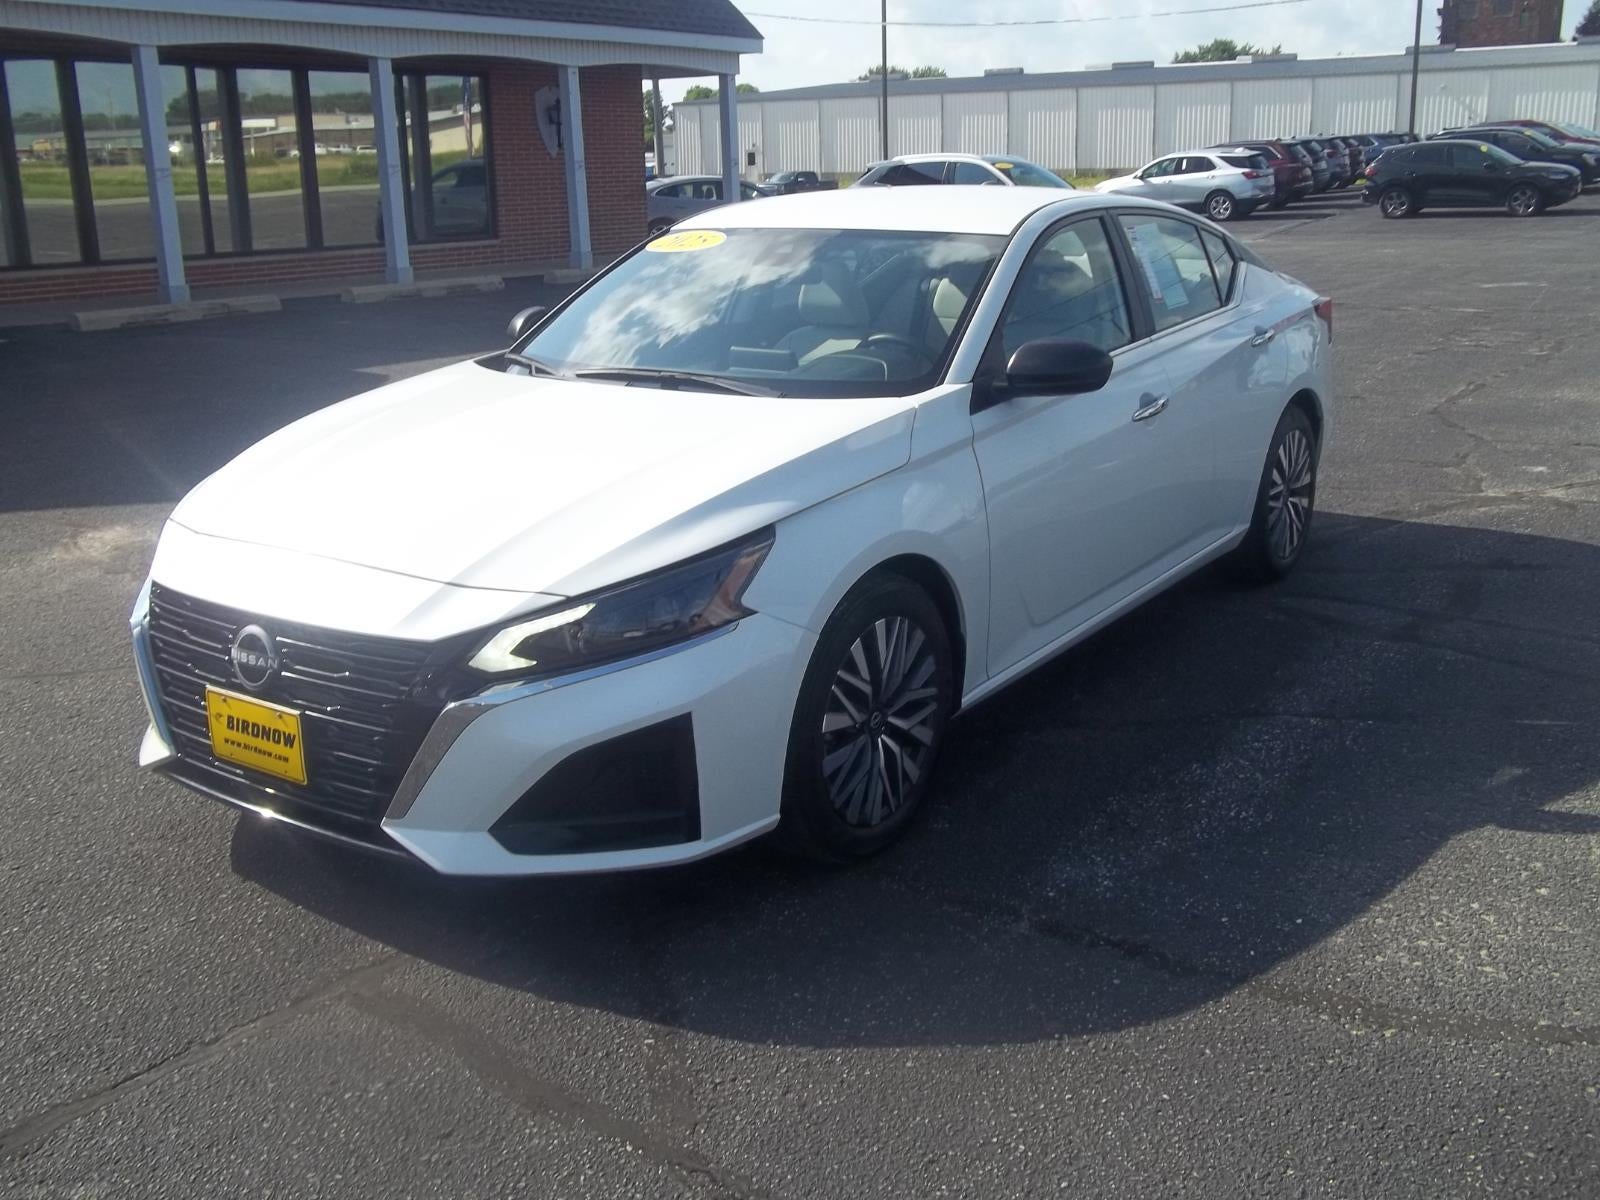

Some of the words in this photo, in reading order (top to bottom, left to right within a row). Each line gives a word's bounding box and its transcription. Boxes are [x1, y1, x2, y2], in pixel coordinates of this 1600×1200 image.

[231, 648, 278, 669] NISSAN
[226, 715, 296, 749] BIRDNOW
[224, 738, 289, 763] www.birdnow.com
